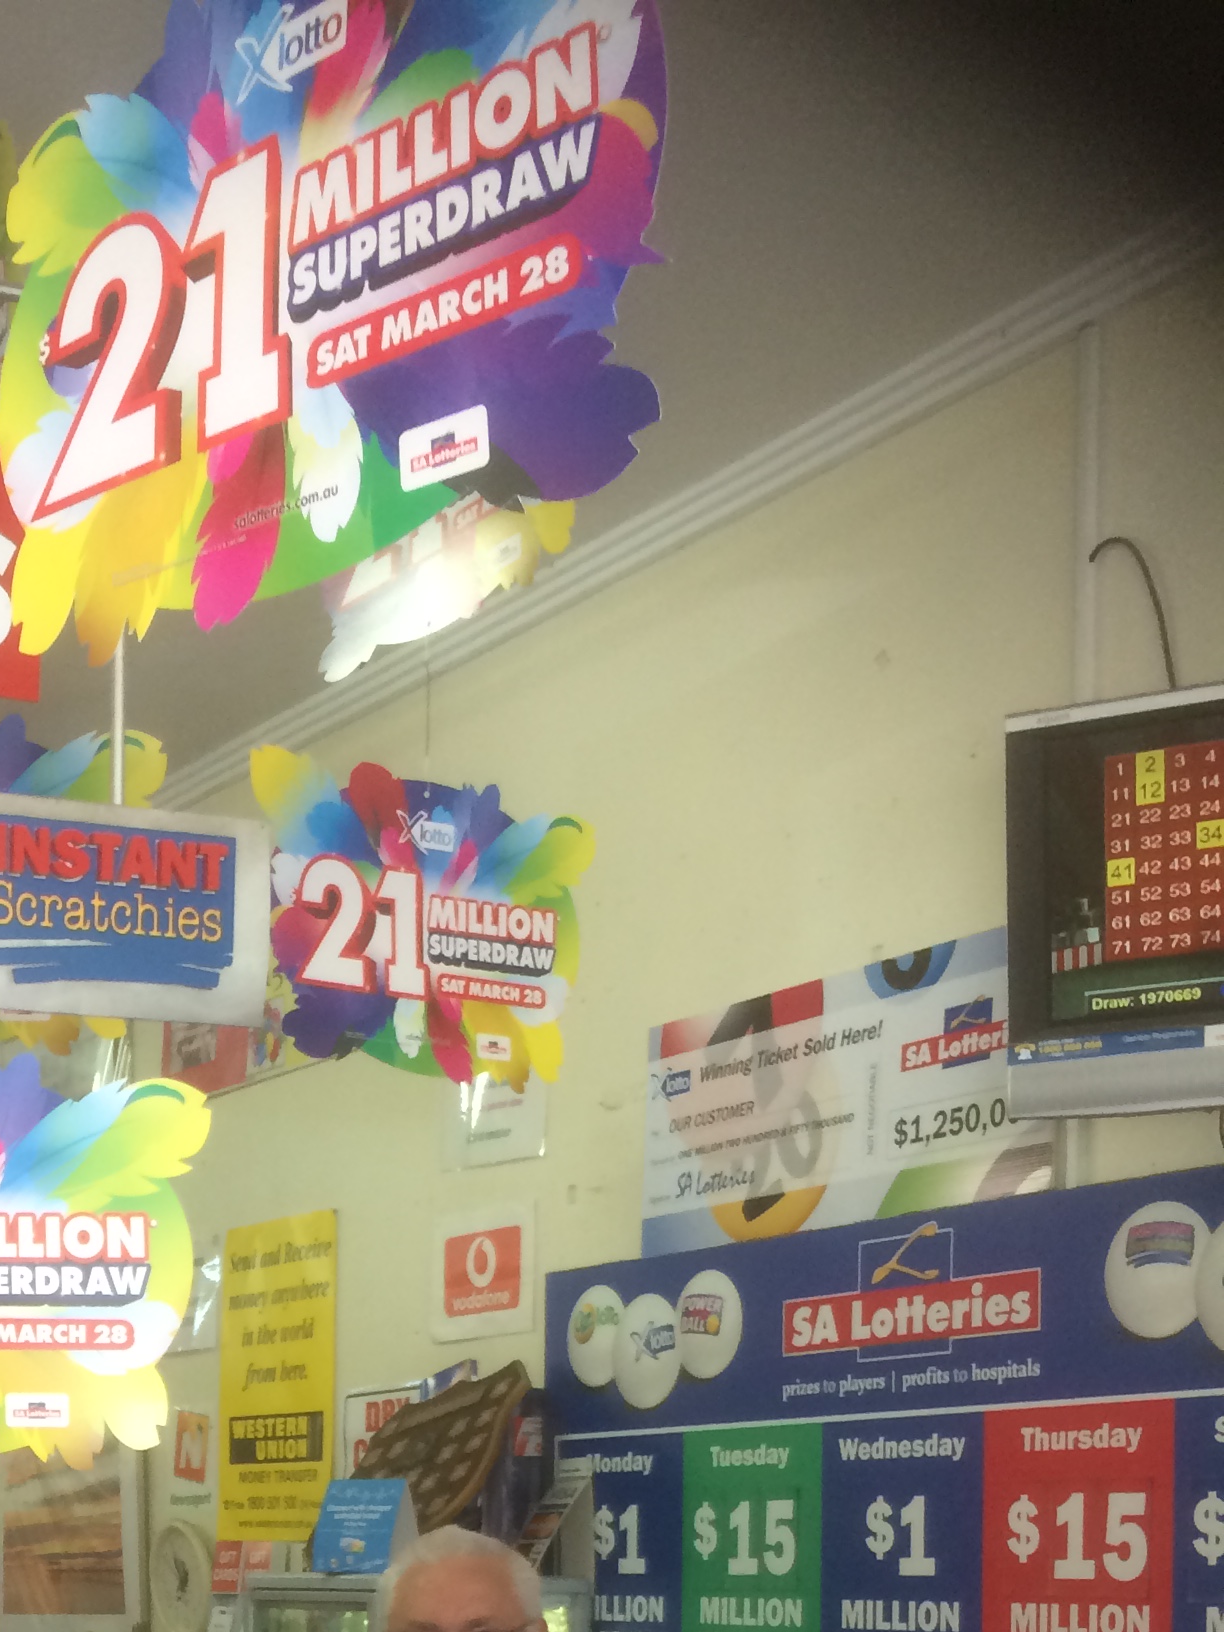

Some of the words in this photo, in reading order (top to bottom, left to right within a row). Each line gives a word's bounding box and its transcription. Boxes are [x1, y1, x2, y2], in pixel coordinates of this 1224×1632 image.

[288, 22, 601, 253] MILLION
[291, 122, 597, 306] SUPERDRAW
[315, 334, 370, 378] SAT
[381, 278, 507, 350] MARCH
[520, 247, 569, 297] 28
[1112, 787, 1129, 801] 11
[1140, 781, 1162, 800] 12
[1171, 778, 1191, 793] 13
[1201, 775, 1220, 789] 14
[1111, 813, 1131, 828] 21
[1139, 808, 1162, 824] 22
[1169, 804, 1192, 820] 23
[1199, 800, 1221, 816] 24
[1111, 839, 1130, 854] 31
[1140, 834, 1163, 850] 32
[1169, 830, 1192, 846] 33
[1199, 825, 1223, 844] 34
[1111, 863, 1132, 881] 41
[1139, 860, 1162, 876] 42
[1169, 856, 1192, 872] 43
[1199, 853, 1222, 868] 44
[428, 894, 557, 945] MILLION
[429, 934, 554, 972] SUPERDRAW
[441, 977, 464, 994] SAT
[469, 981, 520, 1002] MARCH
[524, 989, 542, 1005] 28
[1091, 993, 1134, 1010] Draw:
[1139, 987, 1202, 1005] 1970669
[700, 1054, 752, 1083] Winning
[757, 1043, 797, 1069] Ticket
[803, 1032, 835, 1056] Sold
[840, 1019, 883, 1047] Here!
[905, 1042, 933, 1068] SA
[938, 1023, 1008, 1059] Lotteri
[669, 1111, 693, 1133] OUR
[694, 1100, 755, 1128] CUSTOMER
[893, 1097, 1014, 1147] $1,250,0
[791, 1305, 837, 1347] SA
[851, 1288, 1030, 1343] Lotteries
[93, 1323, 127, 1344] 28
[783, 1380, 820, 1401] prizes
[824, 1380, 837, 1393] to
[840, 1373, 885, 1395] players
[902, 1369, 949, 1388] profits
[954, 1367, 968, 1382] to
[971, 1359, 1040, 1382] hospitals
[232, 1416, 308, 1440] WESTERN
[1021, 1425, 1143, 1454] Thursday
[255, 1438, 308, 1460] UNION
[711, 1444, 789, 1469] Tuesday
[839, 1435, 965, 1462] Wednesday
[693, 1499, 795, 1576] $15
[865, 1494, 936, 1577] $1
[1007, 1491, 1148, 1582] $15
[700, 1598, 802, 1628] MILLION
